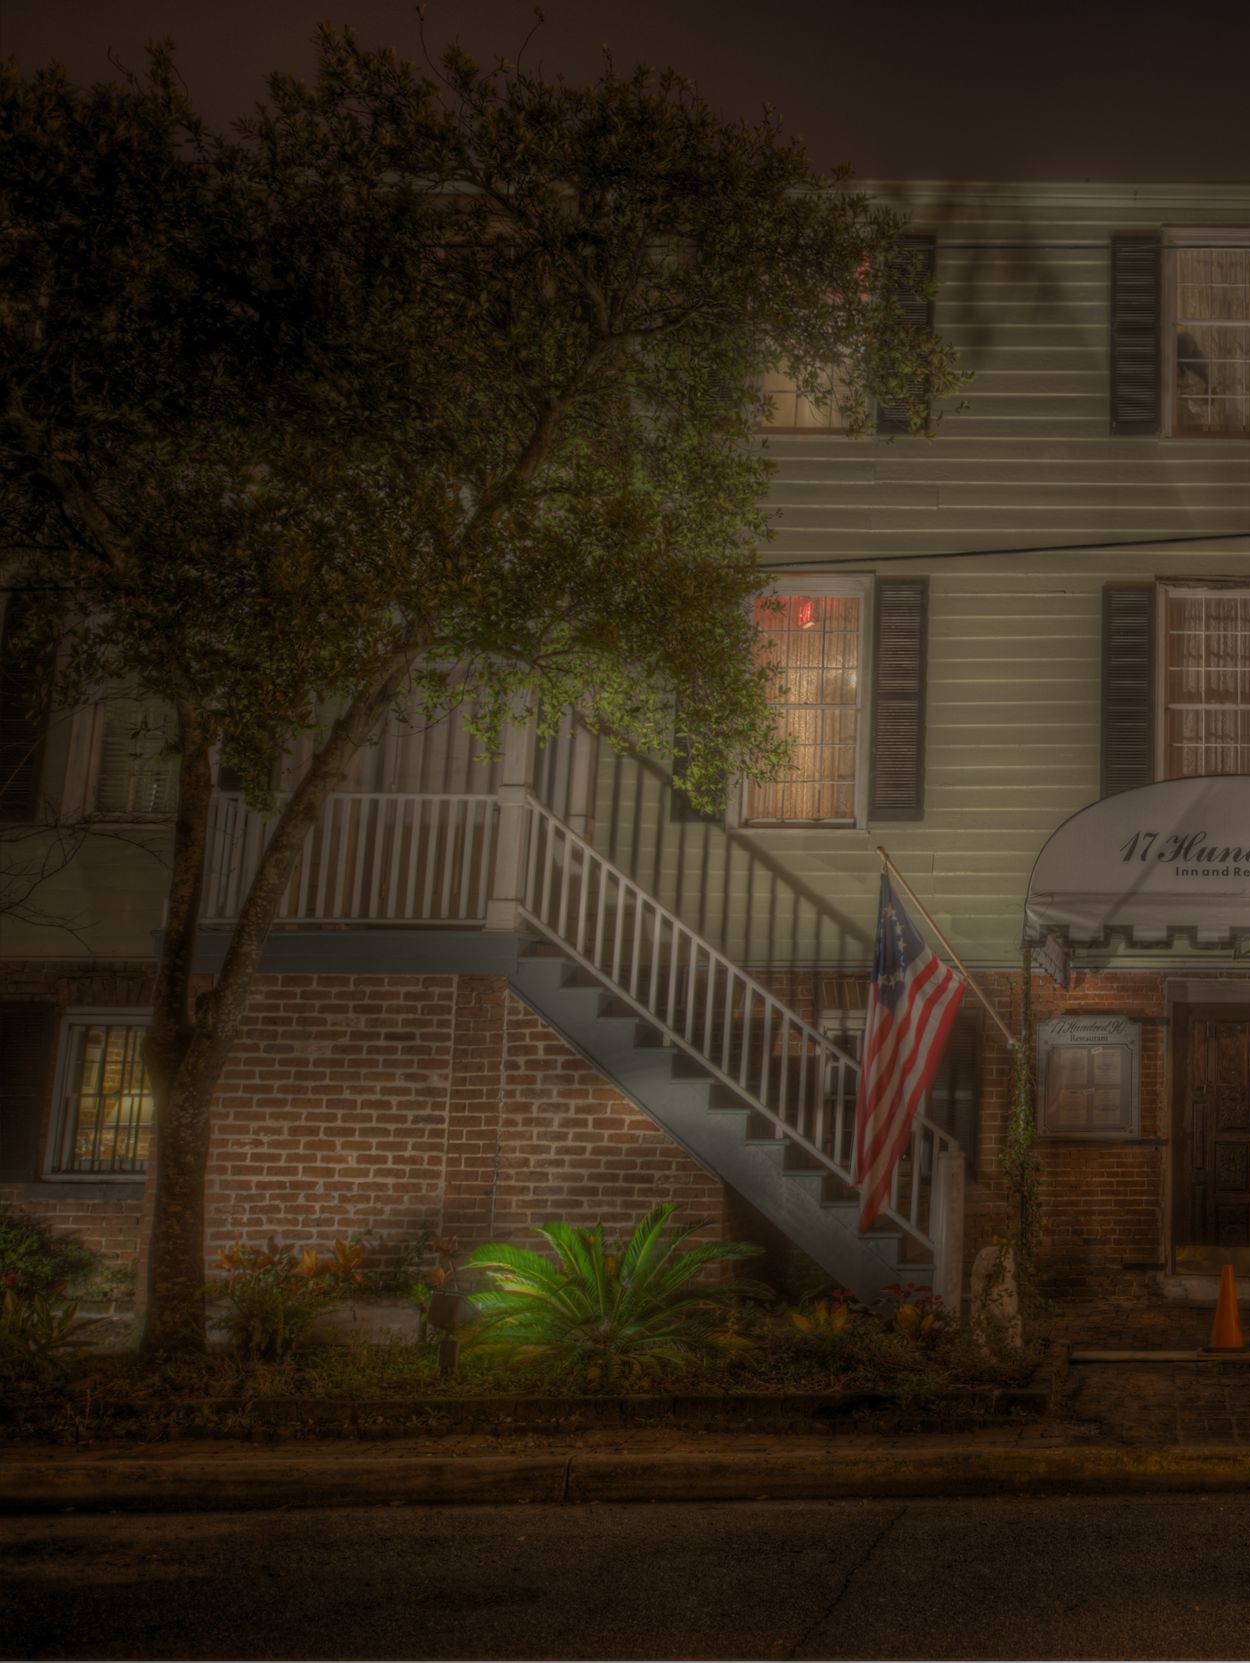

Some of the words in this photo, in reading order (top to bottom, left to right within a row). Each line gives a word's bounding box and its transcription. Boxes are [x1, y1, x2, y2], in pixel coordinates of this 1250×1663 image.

[1119, 831, 1160, 863] 17
[1175, 866, 1199, 877] Inn
[1201, 866, 1230, 877] and
